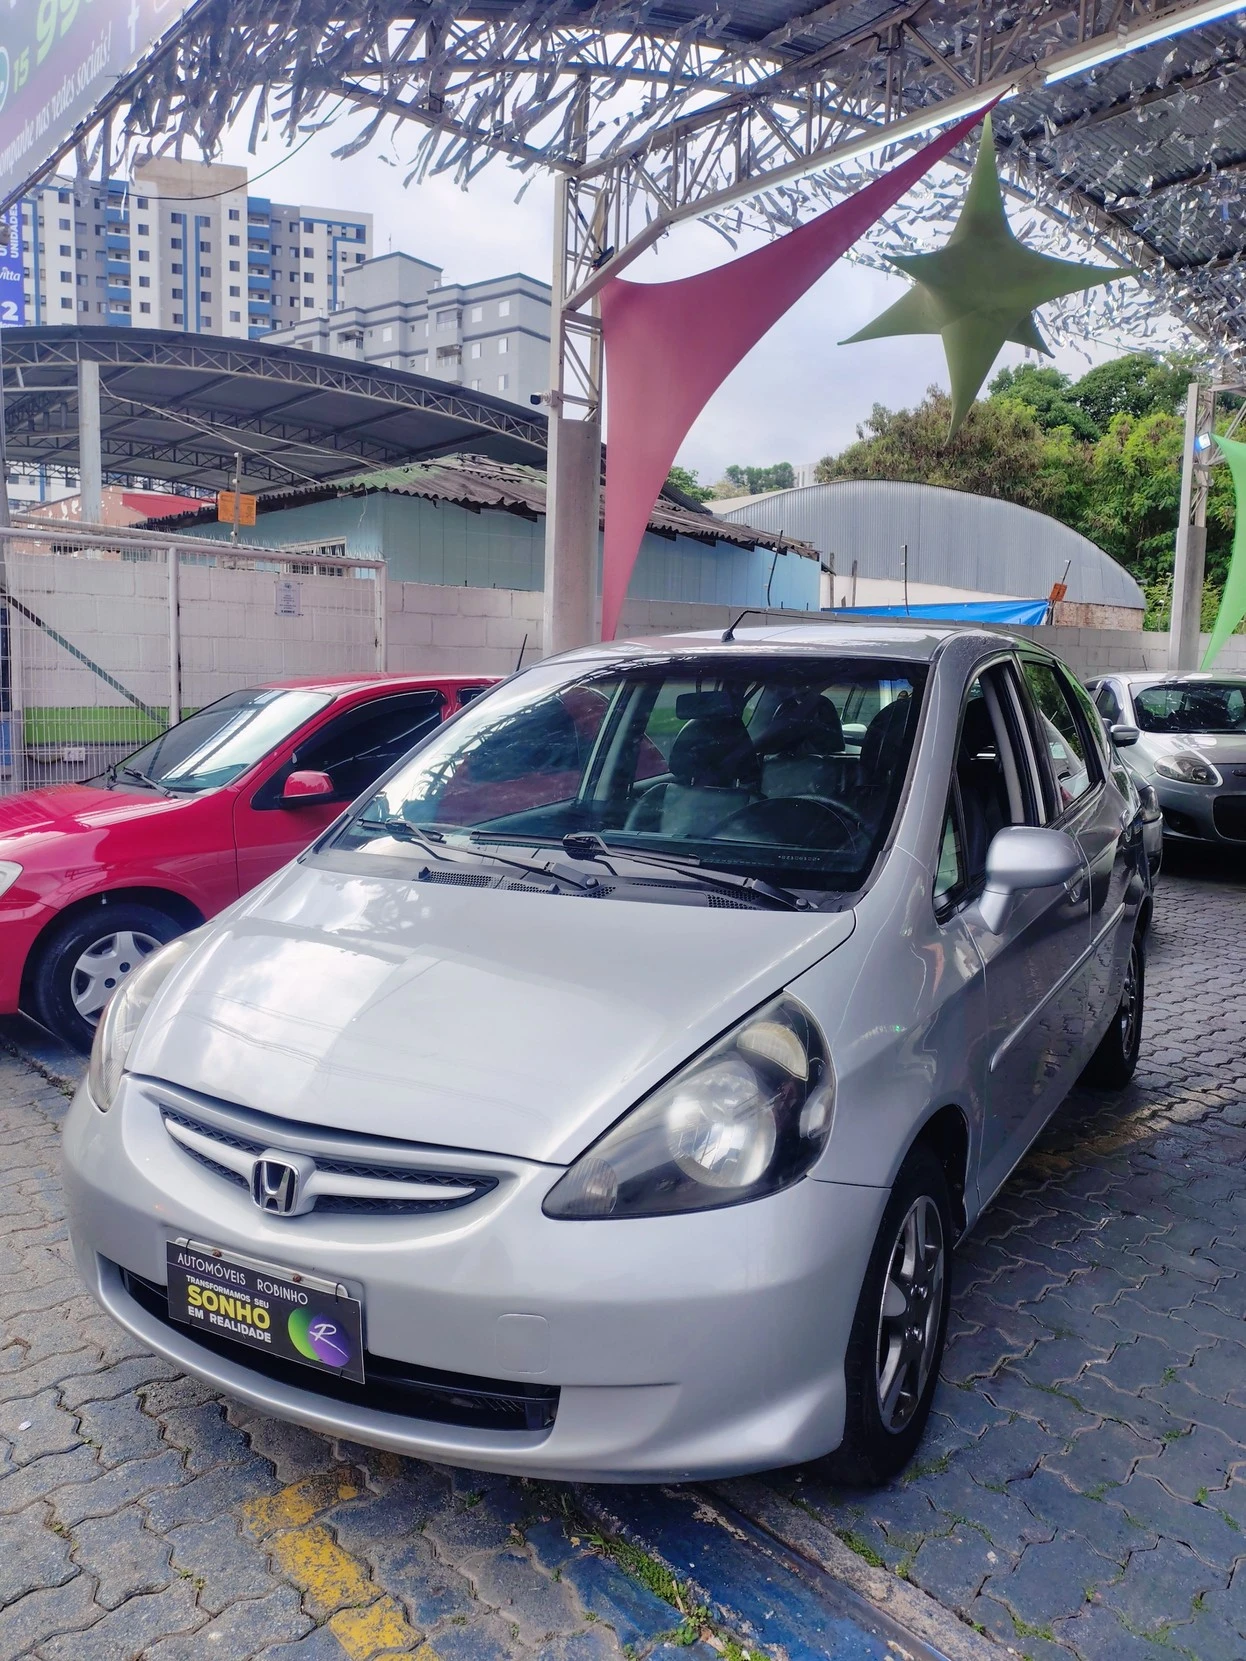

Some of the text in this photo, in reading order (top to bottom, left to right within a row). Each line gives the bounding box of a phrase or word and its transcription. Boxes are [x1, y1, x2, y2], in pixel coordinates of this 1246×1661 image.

[1, 300, 19, 322] 2
[177, 1252, 309, 1305] AUTOMÓVEIS ROBINHO
[186, 1274, 270, 1309] TRANSFORMAMOS SEU
[187, 1284, 270, 1329] SONHO
[188, 1305, 272, 1344] EM REALIDADE
